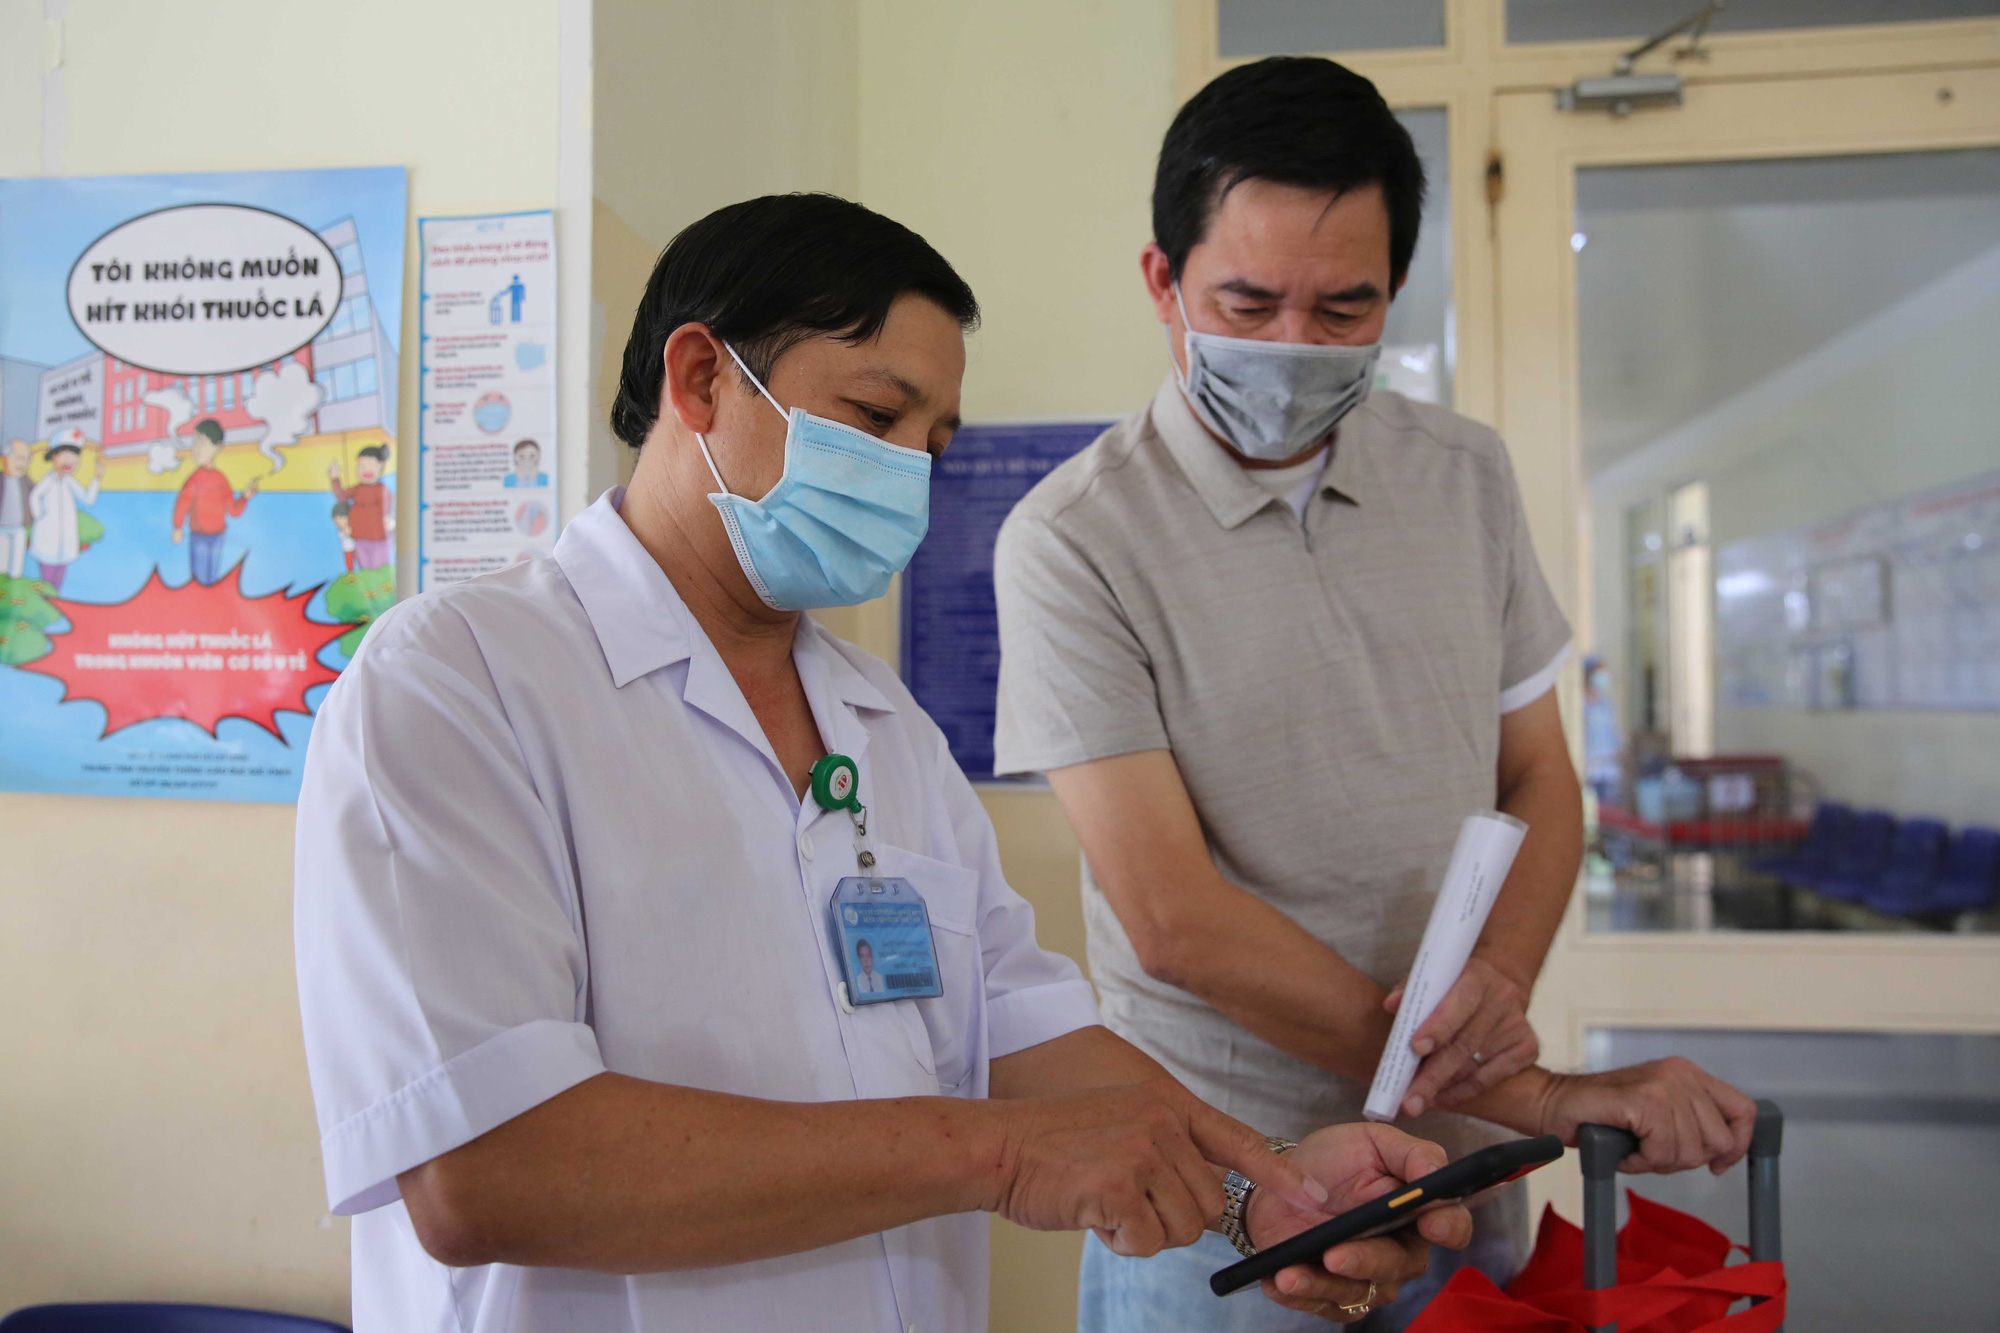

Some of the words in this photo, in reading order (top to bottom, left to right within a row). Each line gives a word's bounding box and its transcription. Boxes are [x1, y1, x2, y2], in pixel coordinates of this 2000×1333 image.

[91, 258, 131, 282] TÔI
[144, 257, 233, 281] KHÔNG
[241, 246, 319, 279] MUỐN
[86, 297, 127, 323] HÍT
[134, 294, 195, 321] KHÓI
[202, 288, 287, 319] THUỐC
[294, 291, 325, 317] LÁ
